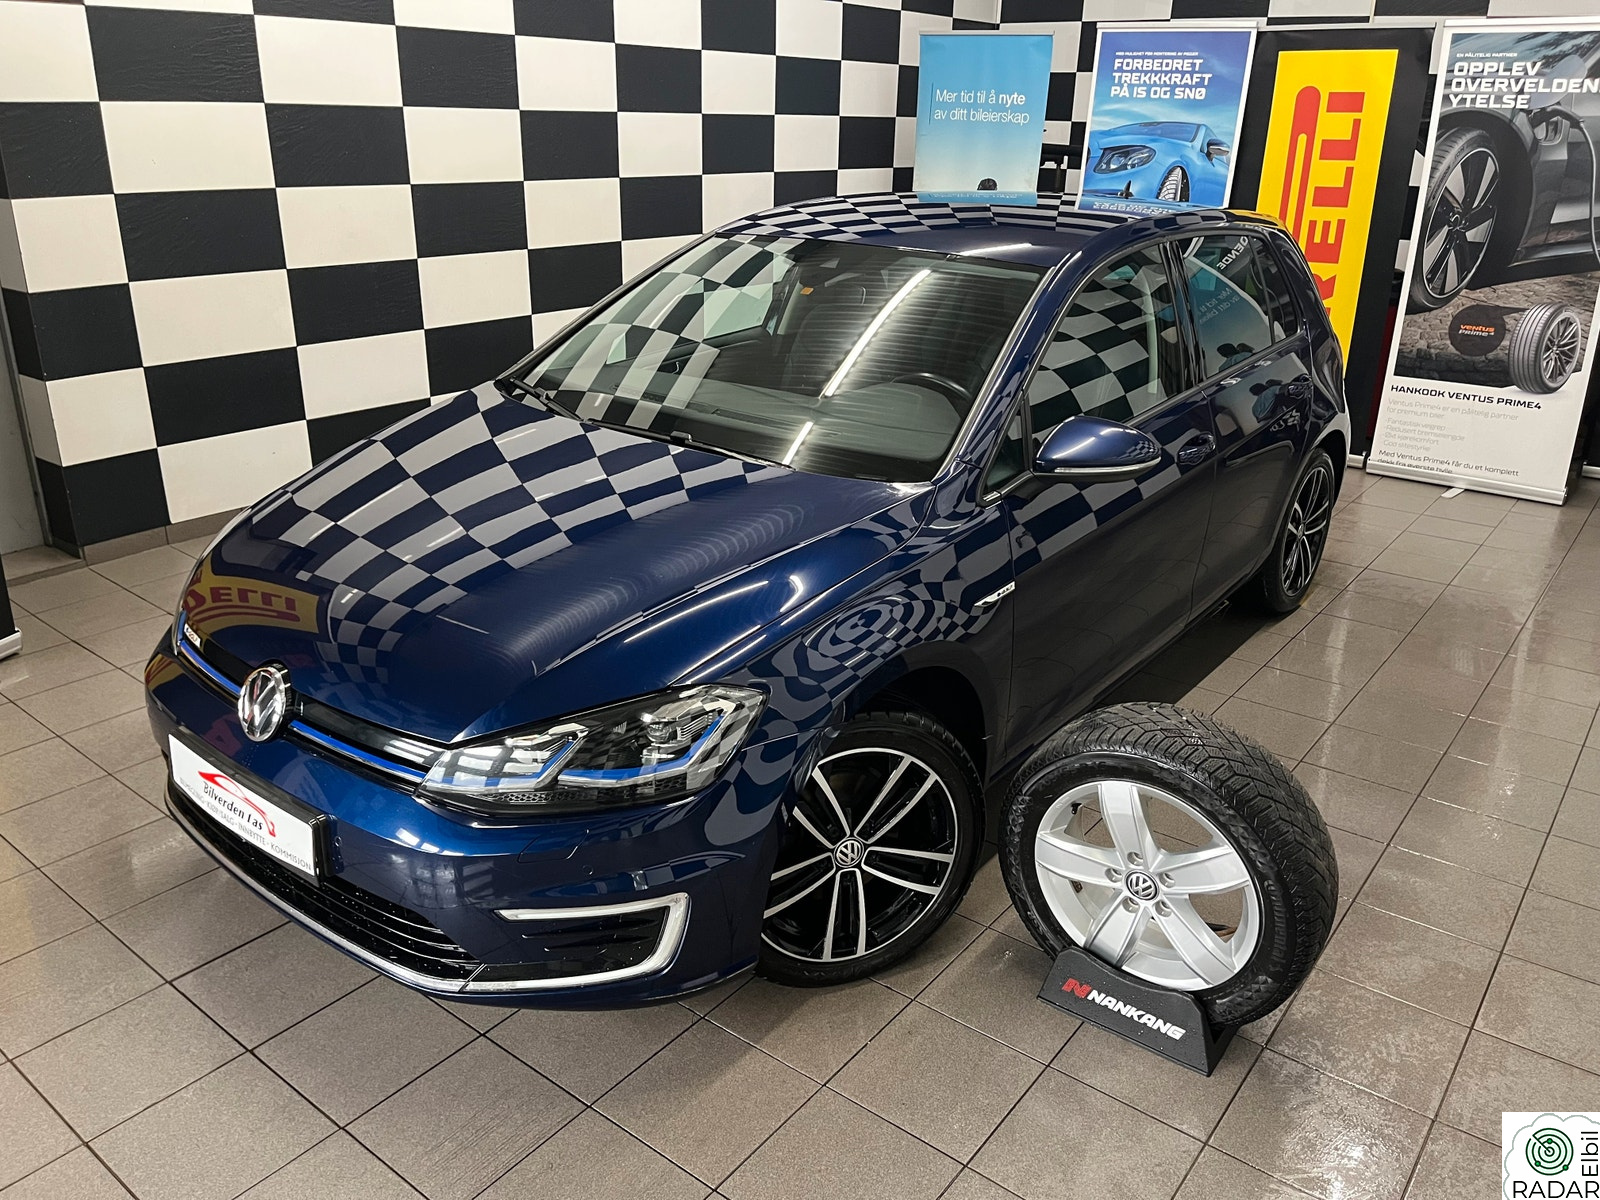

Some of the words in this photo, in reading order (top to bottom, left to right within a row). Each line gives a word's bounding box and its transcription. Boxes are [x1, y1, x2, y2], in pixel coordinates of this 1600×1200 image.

[1114, 59, 1204, 71] FORBEDRET
[1454, 62, 1542, 76] OPPLEV
[1112, 73, 1212, 85] TREKKKRAFT
[1451, 78, 1600, 93] OVERVELDEN
[936, 89, 958, 103] Mer
[961, 90, 974, 104] tid
[977, 90, 985, 104] til
[988, 89, 996, 104] å
[999, 92, 1026, 108] nyte
[1110, 83, 1130, 98] PÅ
[1133, 86, 1147, 98] IS
[1150, 87, 1170, 99] OG
[1174, 87, 1206, 100] SNØ
[1449, 94, 1530, 109] YTELSE
[934, 109, 947, 120] av
[950, 108, 968, 120] ditt
[970, 108, 1030, 126] bileierskap
[1391, 384, 1445, 398] HANKOOK
[1448, 391, 1494, 404] VENTUS
[1496, 397, 1542, 410] PRIME4
[1388, 399, 1413, 408] Ventus
[1415, 401, 1441, 411] Prime4
[1490, 411, 1519, 422] partner
[1398, 408, 1430, 418] premium
[1378, 450, 1395, 458] Med
[1396, 452, 1422, 462] Ventus
[1423, 456, 1451, 466] Prime4
[1451, 459, 1462, 468] får
[1484, 465, 1519, 476] komplett
[203, 781, 245, 818] Bilverden
[251, 818, 263, 830] as
[270, 841, 312, 871] KOMMISJON
[1087, 989, 1186, 1040] NANKANG
